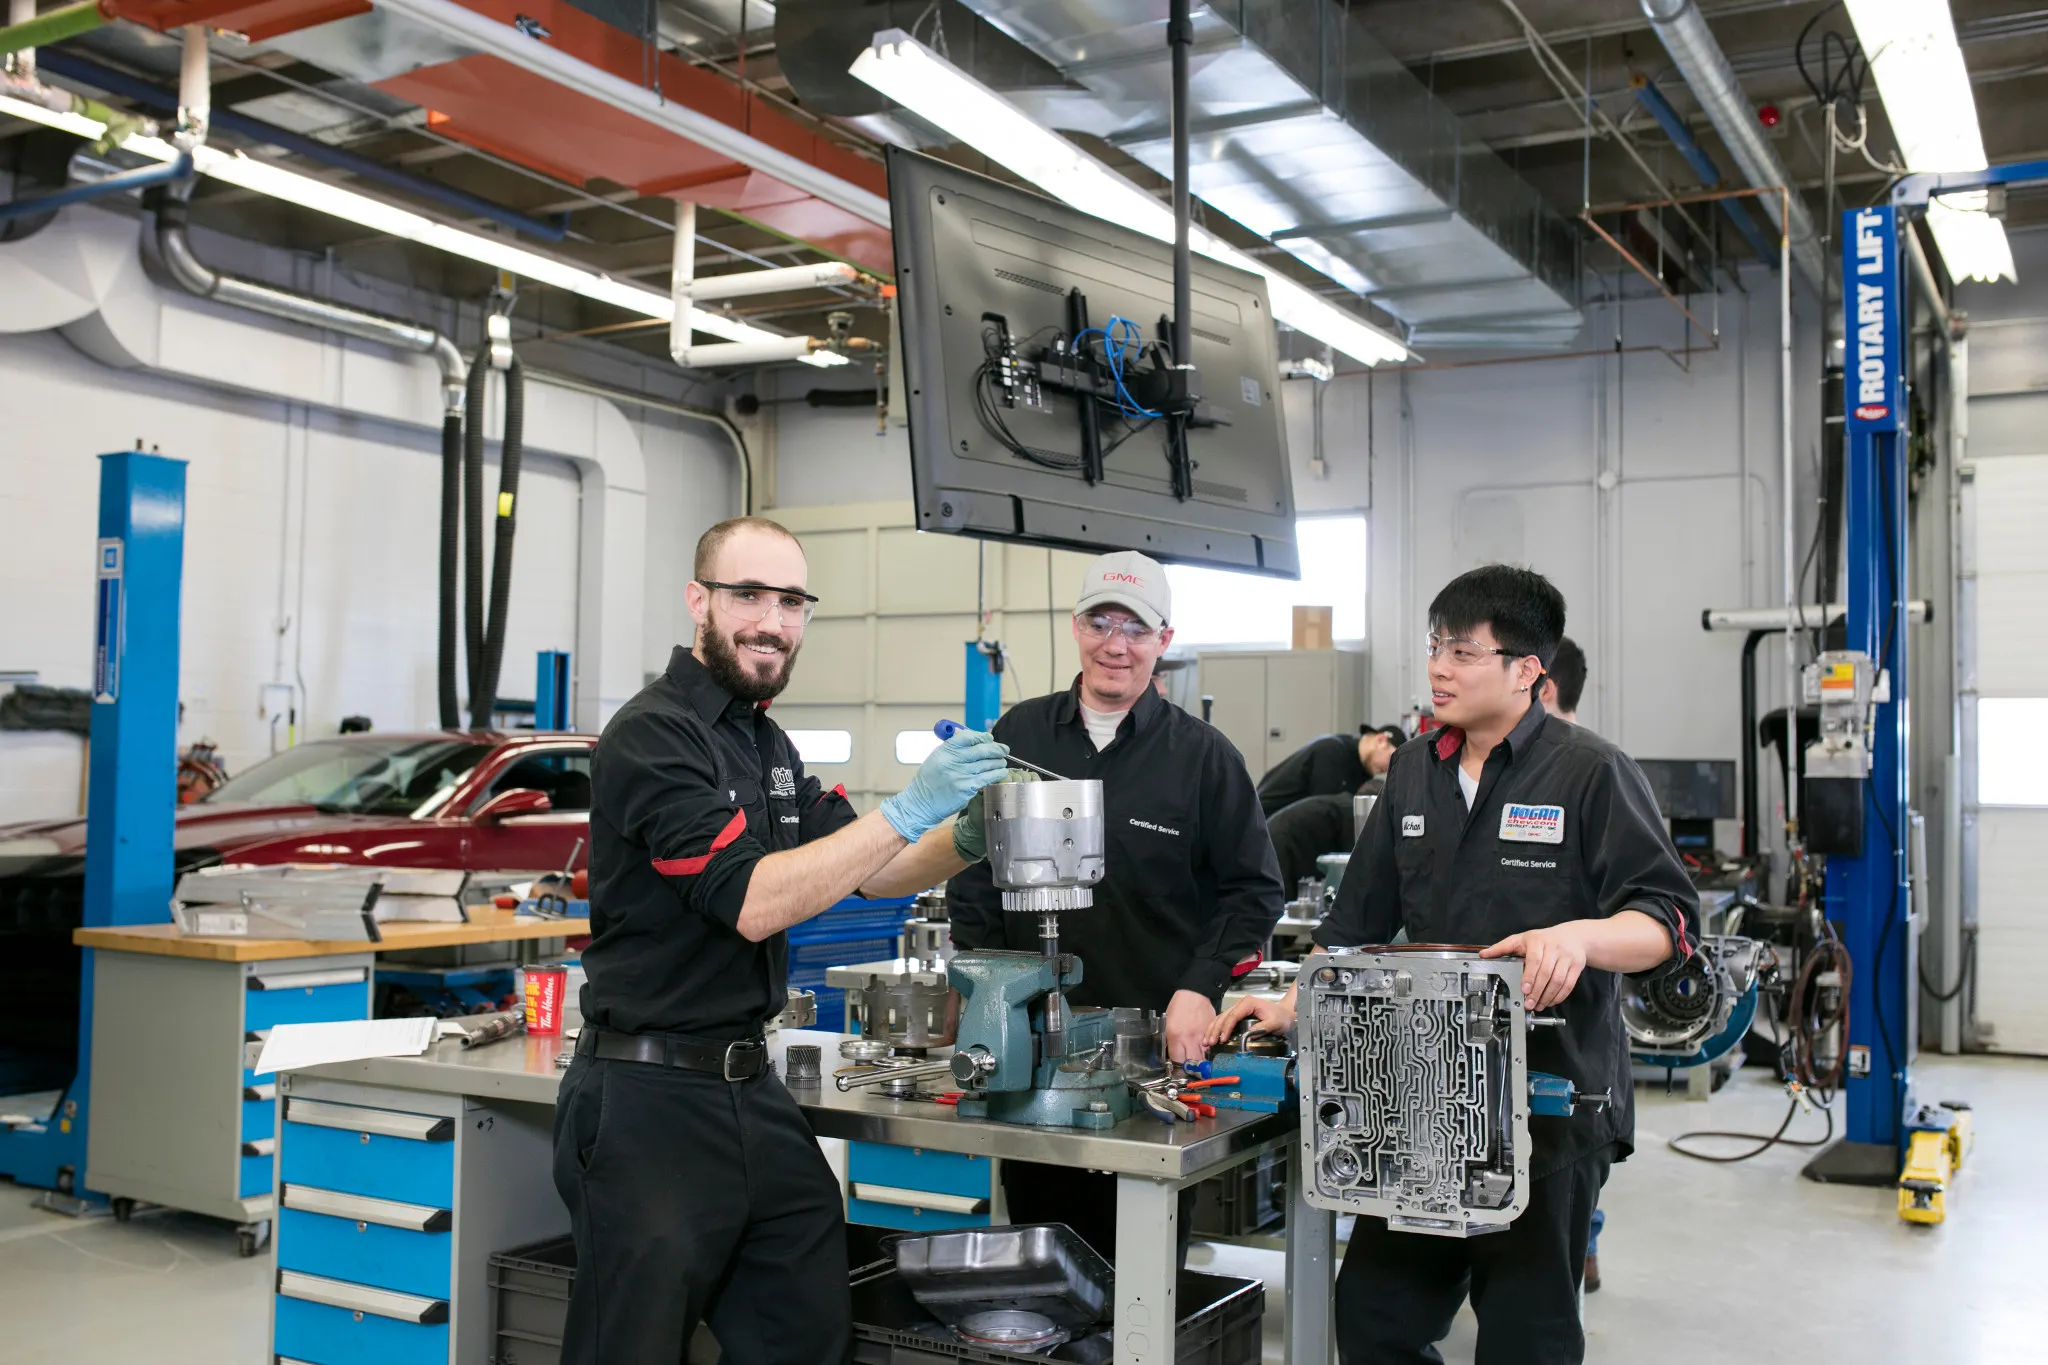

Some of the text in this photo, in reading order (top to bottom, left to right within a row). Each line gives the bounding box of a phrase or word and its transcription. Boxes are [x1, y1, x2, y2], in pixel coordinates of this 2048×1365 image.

[1856, 211, 1884, 276] LIFT
[1857, 282, 1885, 404] ROTARY
[1103, 572, 1145, 588] GMC
[1508, 806, 1561, 821] HOGAN
[1129, 818, 1180, 836] Certified Service
[1507, 818, 1557, 827] chev.com
[1500, 857, 1557, 869] Certified Service
[540, 976, 554, 1028] Tim Hortons
